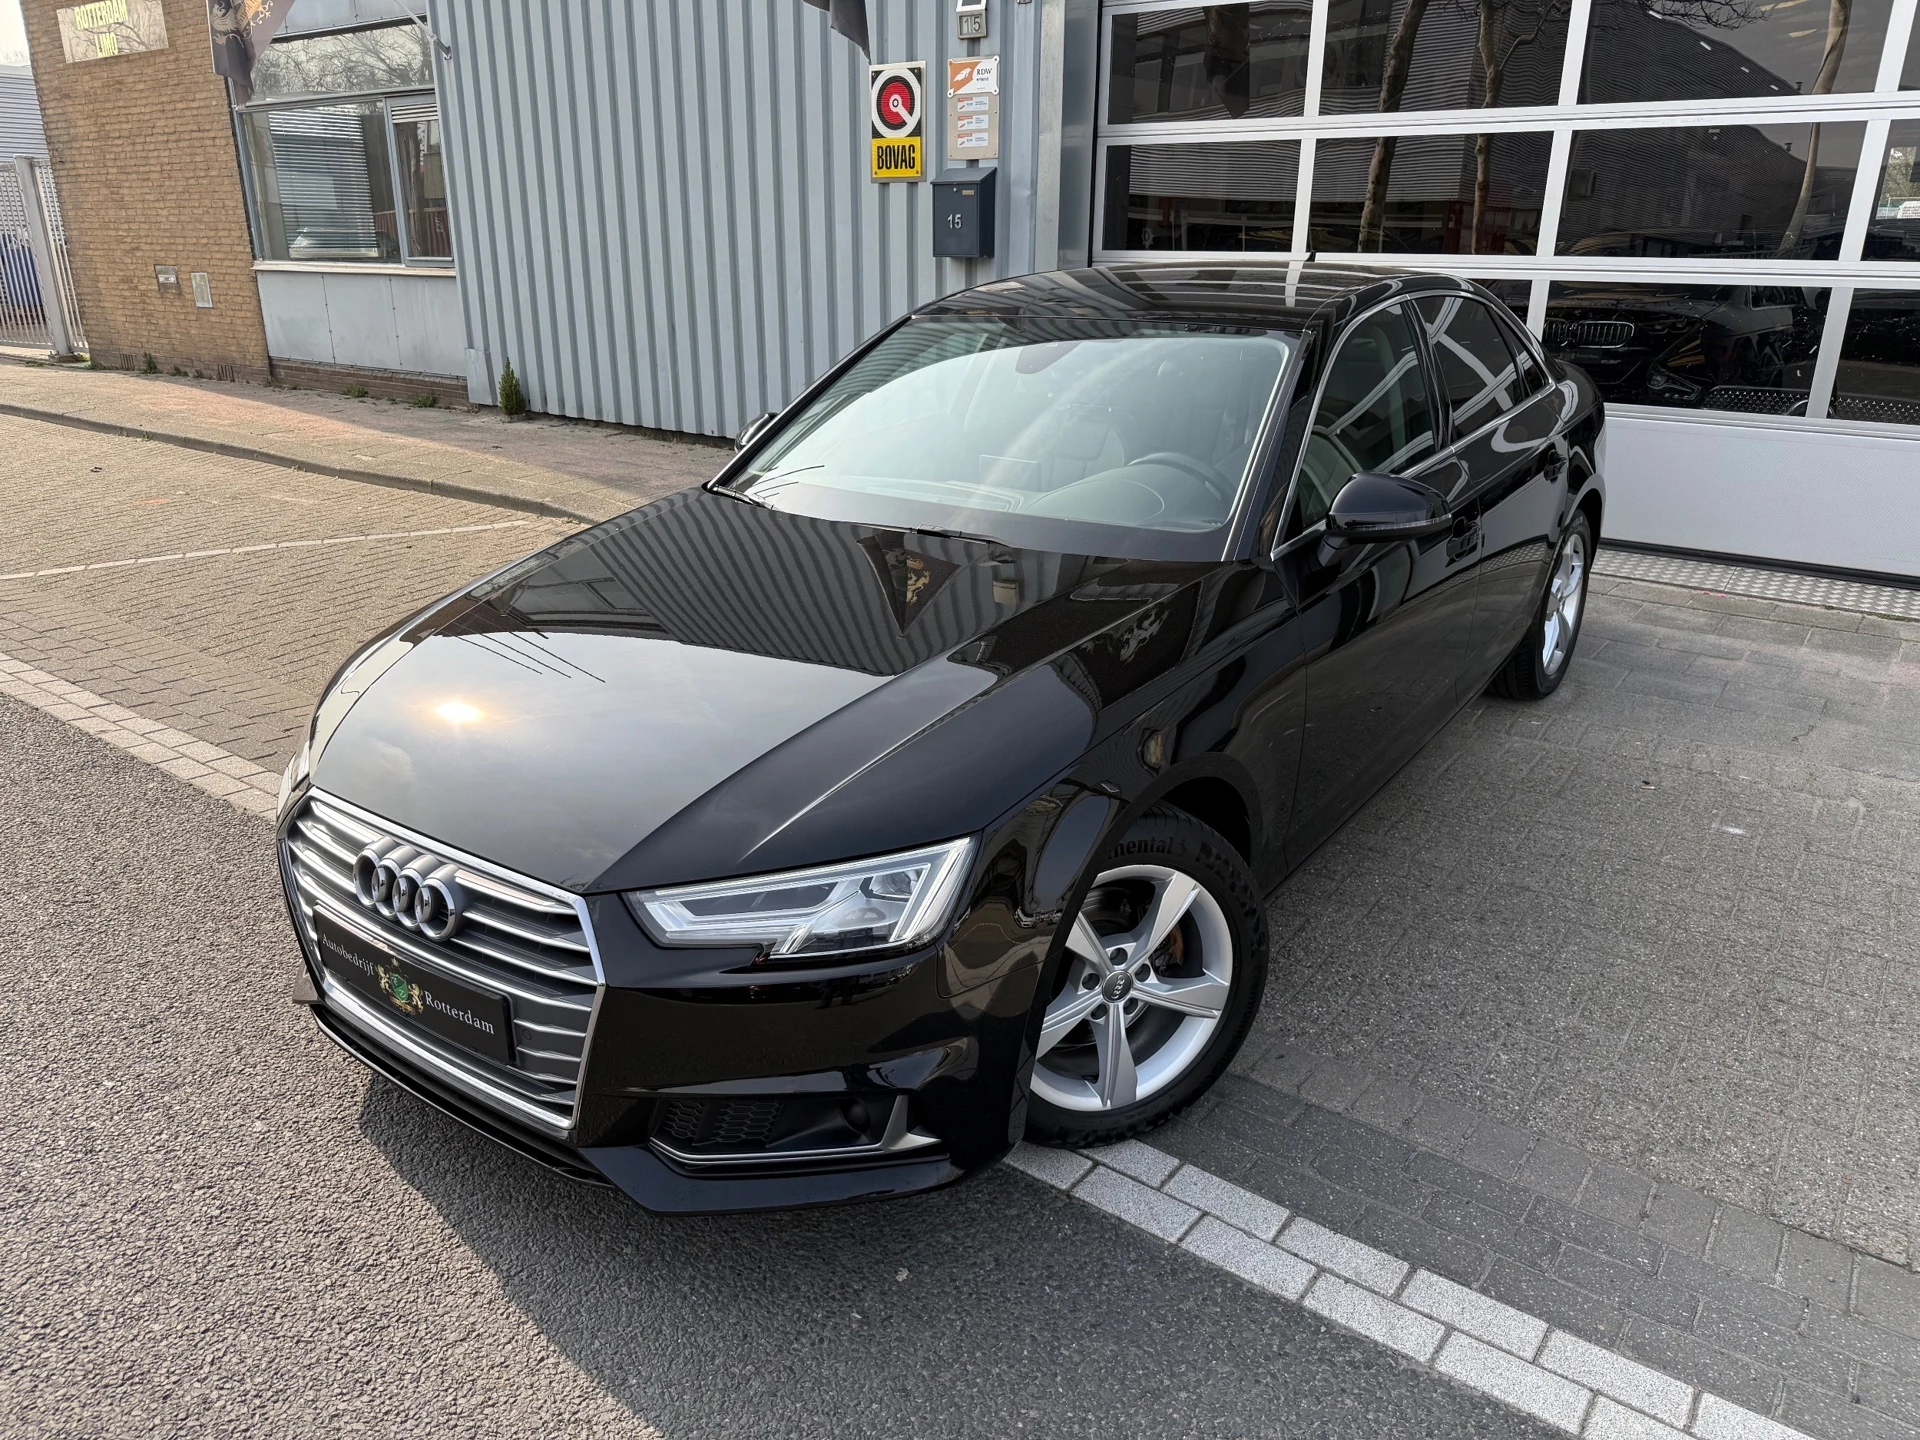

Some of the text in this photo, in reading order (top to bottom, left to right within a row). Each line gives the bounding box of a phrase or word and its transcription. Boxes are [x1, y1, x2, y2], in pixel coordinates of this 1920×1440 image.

[74, 0, 128, 30] ROTTERDAM
[964, 16, 981, 33] 15
[94, 31, 119, 58] LIMO
[976, 68, 993, 76] RDW
[877, 143, 916, 170] BOVAG
[947, 213, 962, 229] 15
[1108, 835, 1174, 860] nental
[322, 933, 495, 1035] Autobedrijf Rotterdam
